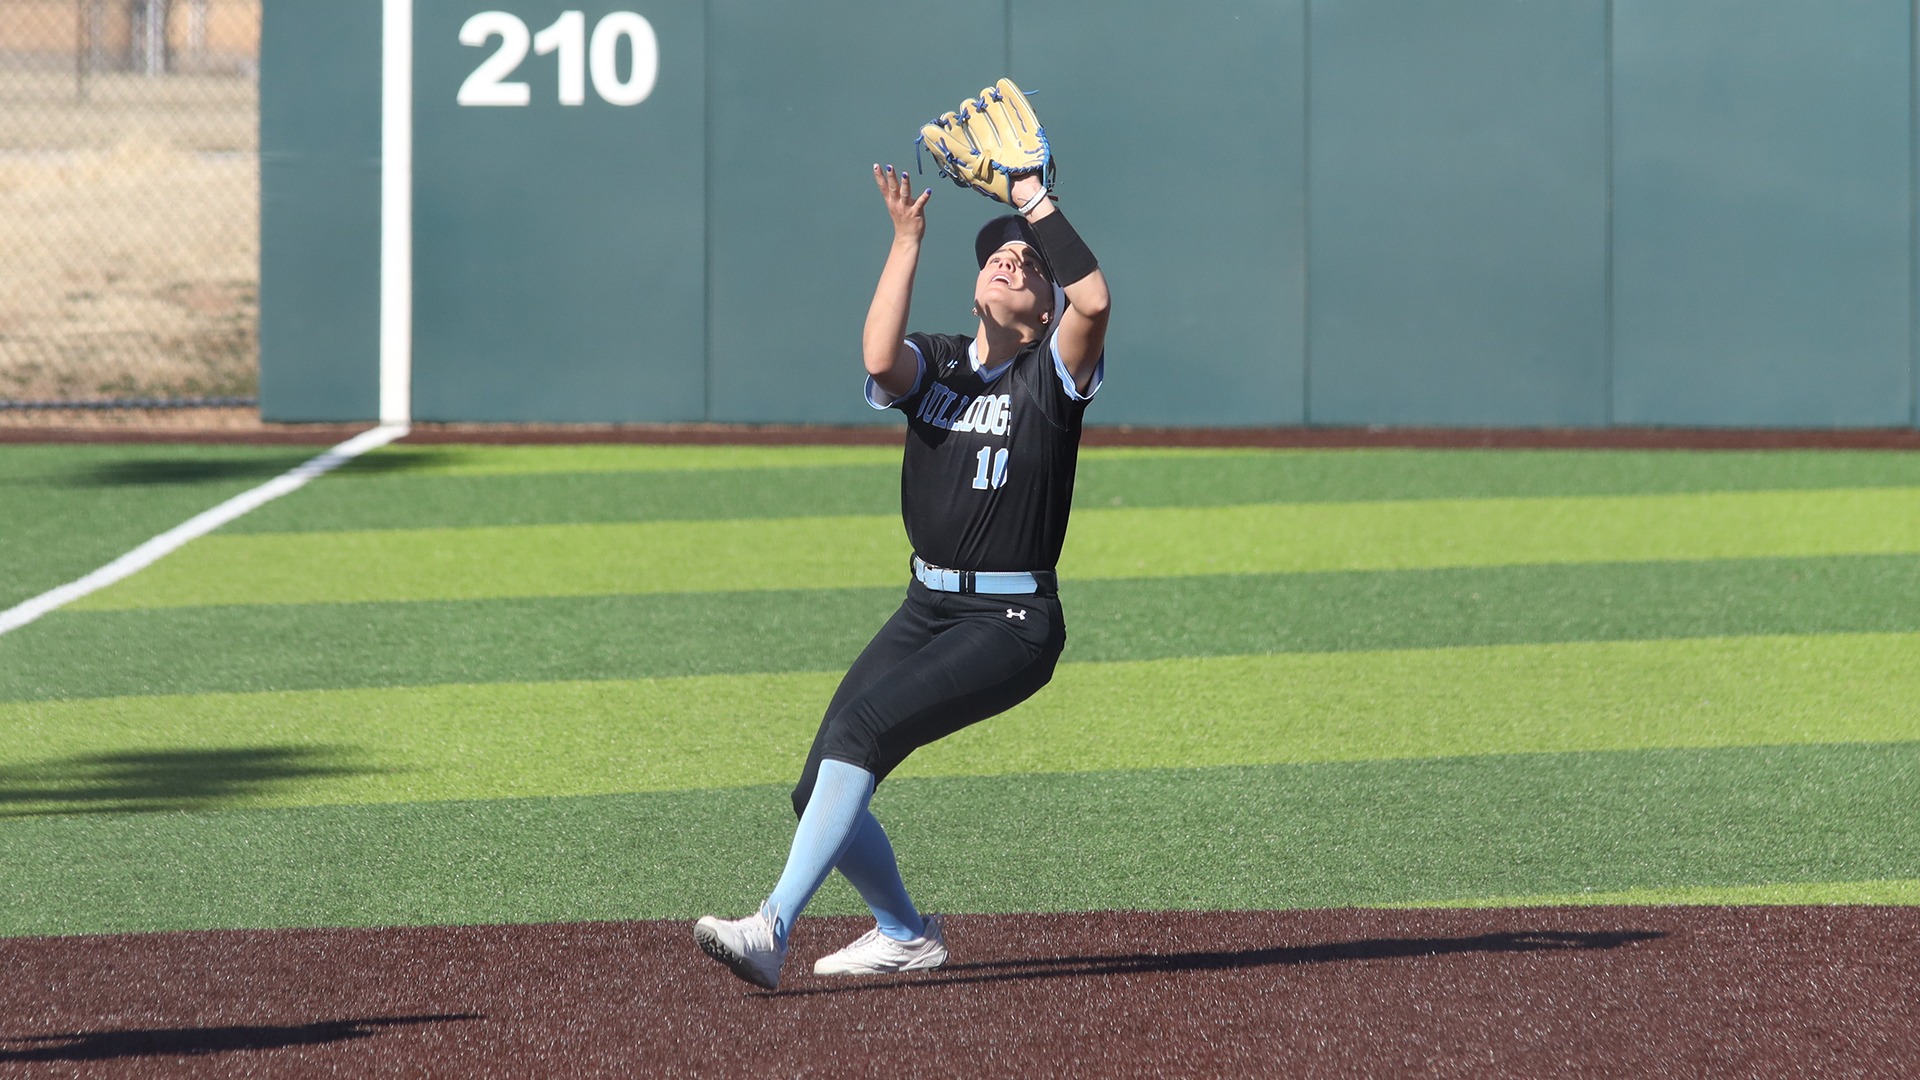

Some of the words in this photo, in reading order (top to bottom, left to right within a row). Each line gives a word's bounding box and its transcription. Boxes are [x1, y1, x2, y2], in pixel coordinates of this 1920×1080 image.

[457, 10, 659, 106] 210
[917, 381, 1012, 436] ULLDOG
[972, 446, 1009, 489] 10
